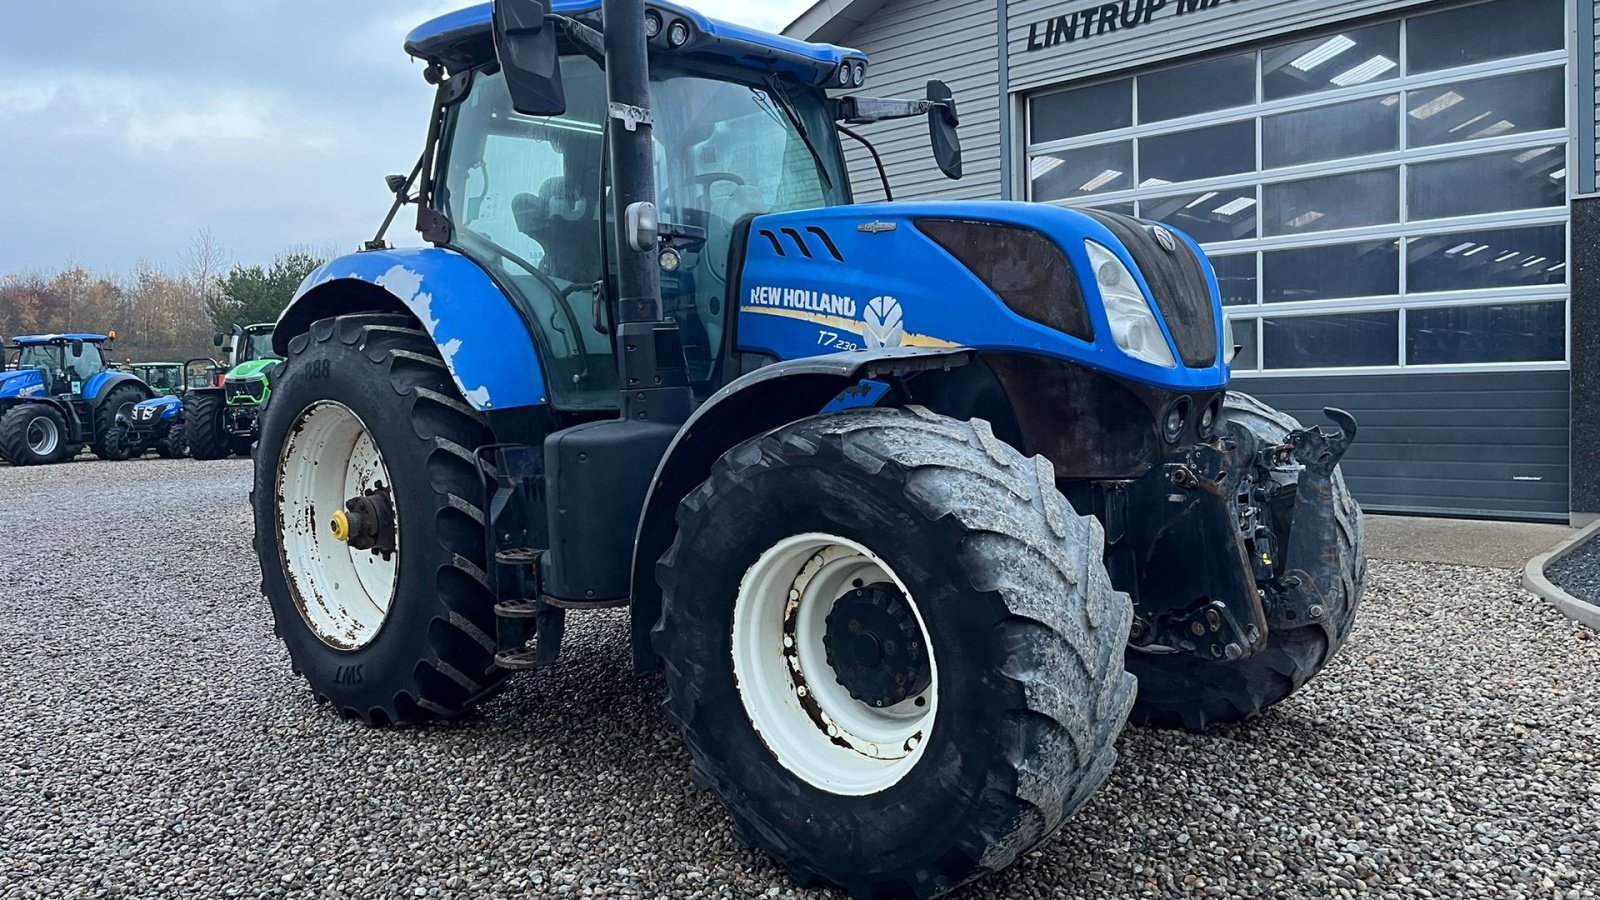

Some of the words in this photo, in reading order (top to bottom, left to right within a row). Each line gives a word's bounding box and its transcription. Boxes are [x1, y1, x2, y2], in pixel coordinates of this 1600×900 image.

[1027, 0, 1167, 51] LINTRUP
[750, 286, 782, 306] NEW
[783, 288, 857, 317] HOLLAND
